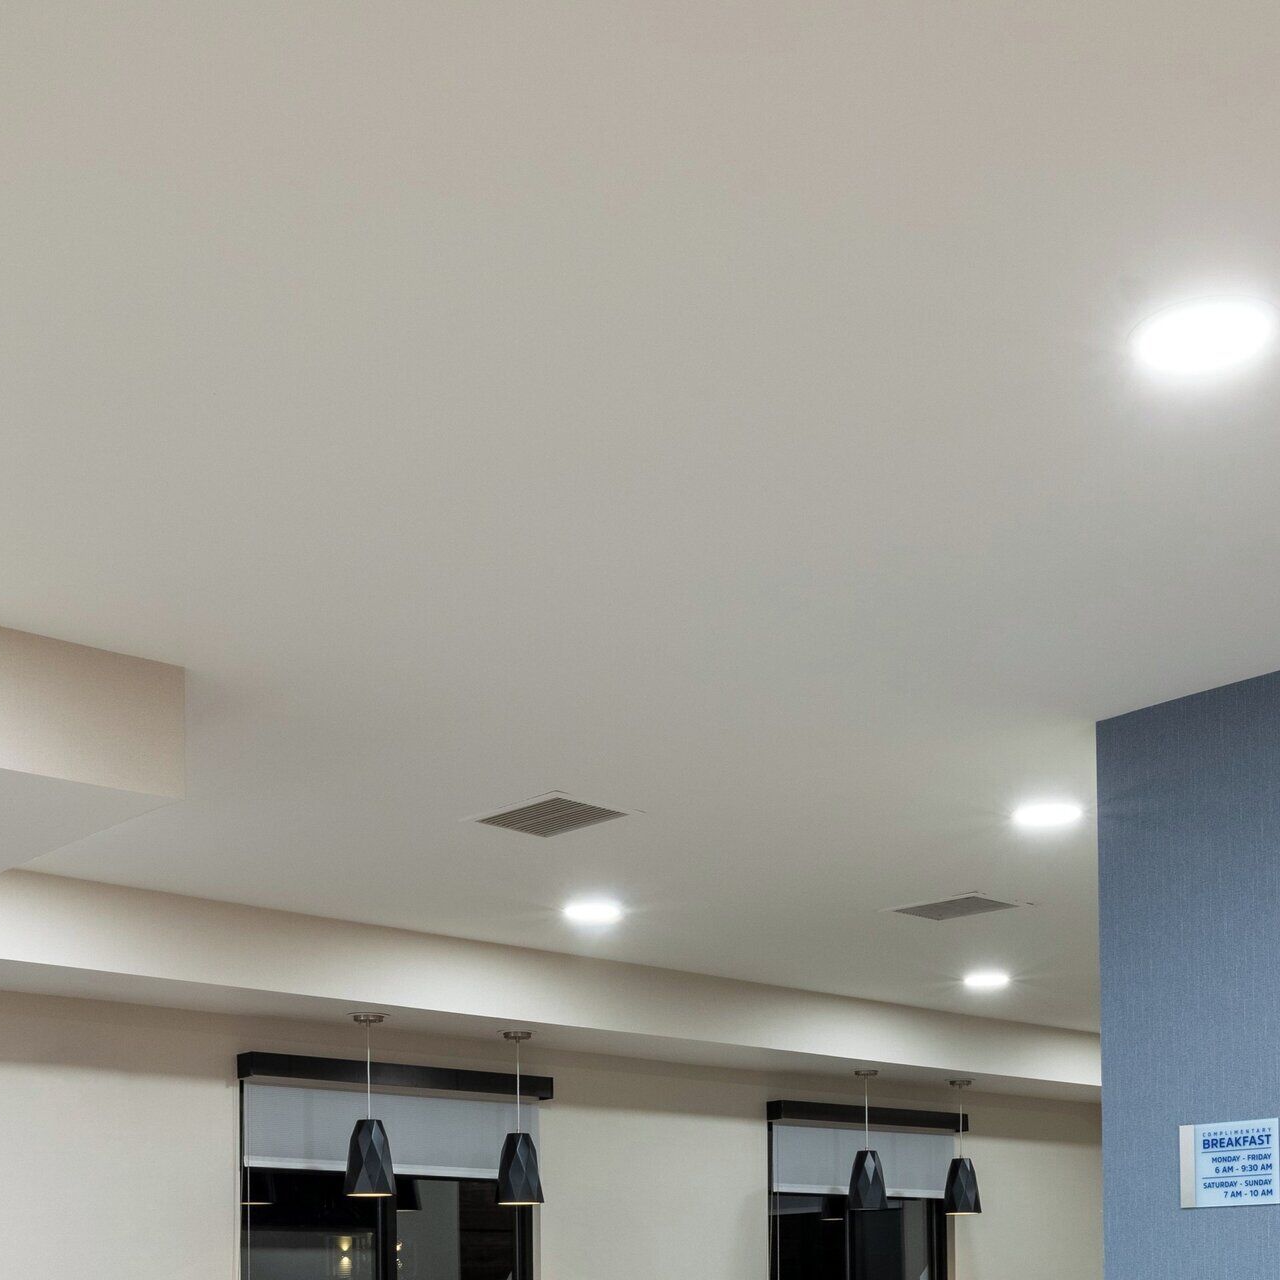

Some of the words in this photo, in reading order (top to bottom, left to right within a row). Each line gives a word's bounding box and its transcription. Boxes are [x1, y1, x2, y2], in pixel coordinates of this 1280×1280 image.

[1202, 1127, 1272, 1138] COMPLIMENTARY
[1202, 1134, 1272, 1150] BREAKFAST
[1211, 1155, 1241, 1164] MONDAY
[1247, 1153, 1272, 1161] FRIDAY
[1214, 1166, 1220, 1174] 6
[1221, 1165, 1234, 1173] AM
[1241, 1164, 1259, 1173] 9:30
[1260, 1163, 1273, 1171] AM
[1203, 1180, 1238, 1189] SATURDAY
[1244, 1179, 1273, 1187] SUNDAY
[1223, 1191, 1229, 1199] 7
[1230, 1190, 1243, 1198] AM
[1261, 1189, 1273, 1197] AM
